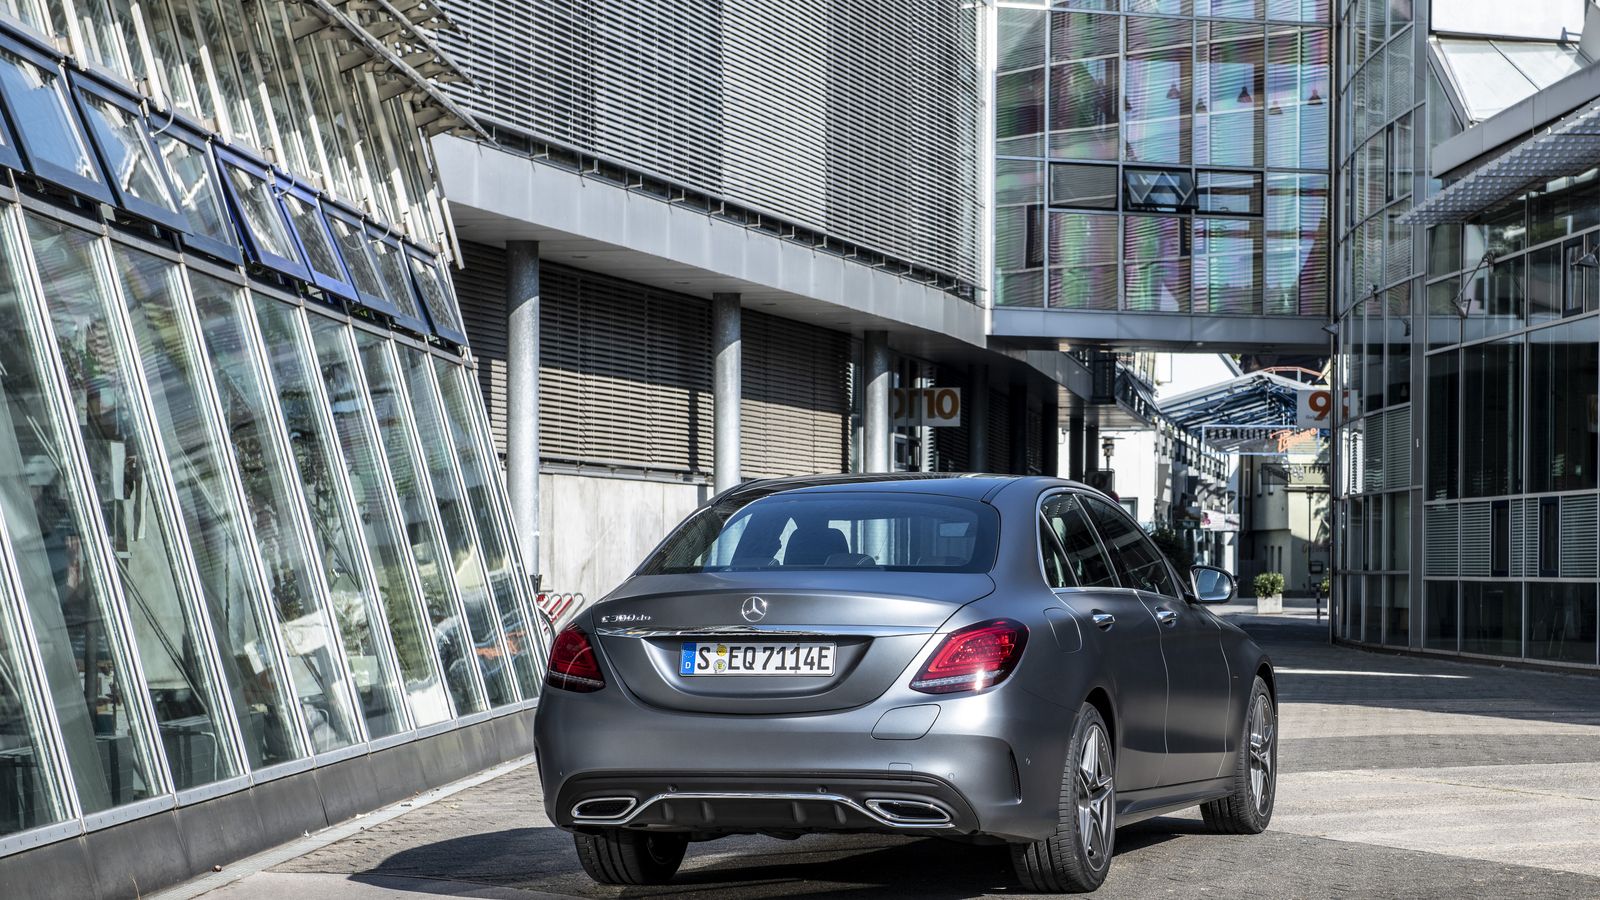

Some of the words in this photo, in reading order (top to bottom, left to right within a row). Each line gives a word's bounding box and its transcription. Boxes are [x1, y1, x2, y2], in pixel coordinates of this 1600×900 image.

[923, 389, 959, 420] 10
[1308, 391, 1331, 421] 9
[697, 646, 711, 670] S
